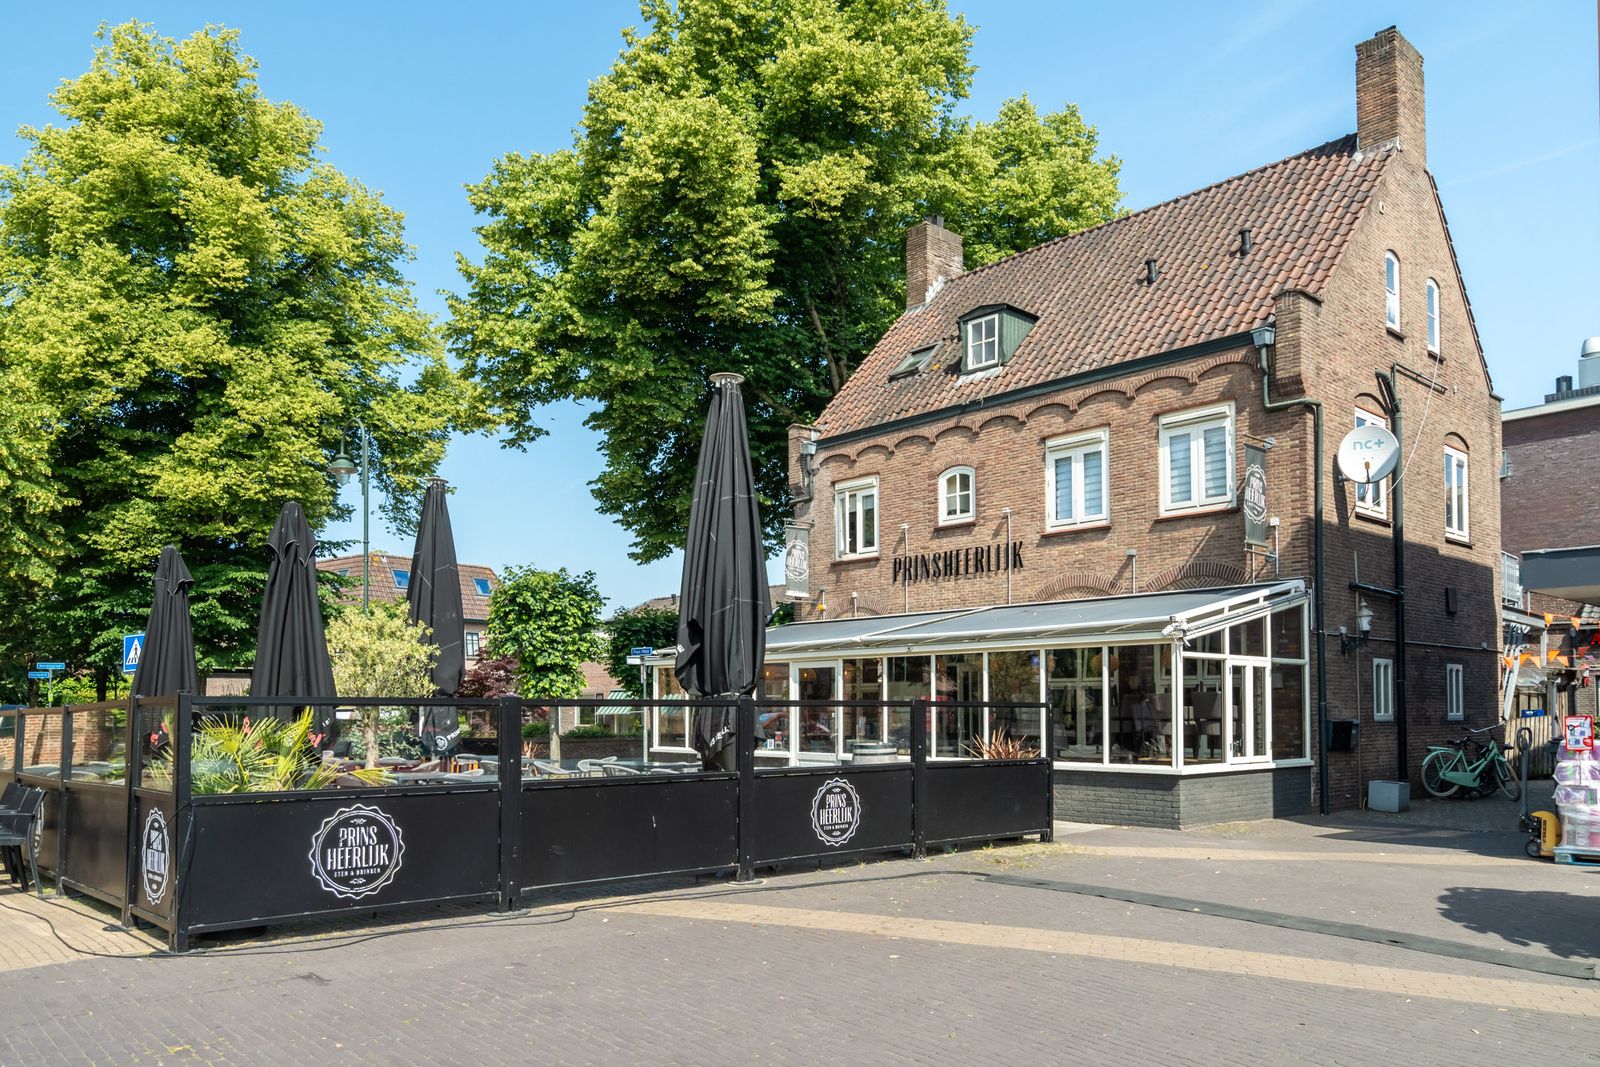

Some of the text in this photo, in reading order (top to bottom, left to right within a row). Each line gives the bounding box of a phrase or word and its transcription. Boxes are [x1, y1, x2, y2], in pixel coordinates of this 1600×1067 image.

[1352, 437, 1384, 451] nc+
[826, 793, 846, 809] PRINS
[820, 807, 852, 825] HEERLIJK
[339, 825, 378, 847] PRINS
[328, 844, 388, 870] HEERLIJK
[356, 868, 380, 876] DRINKEN
